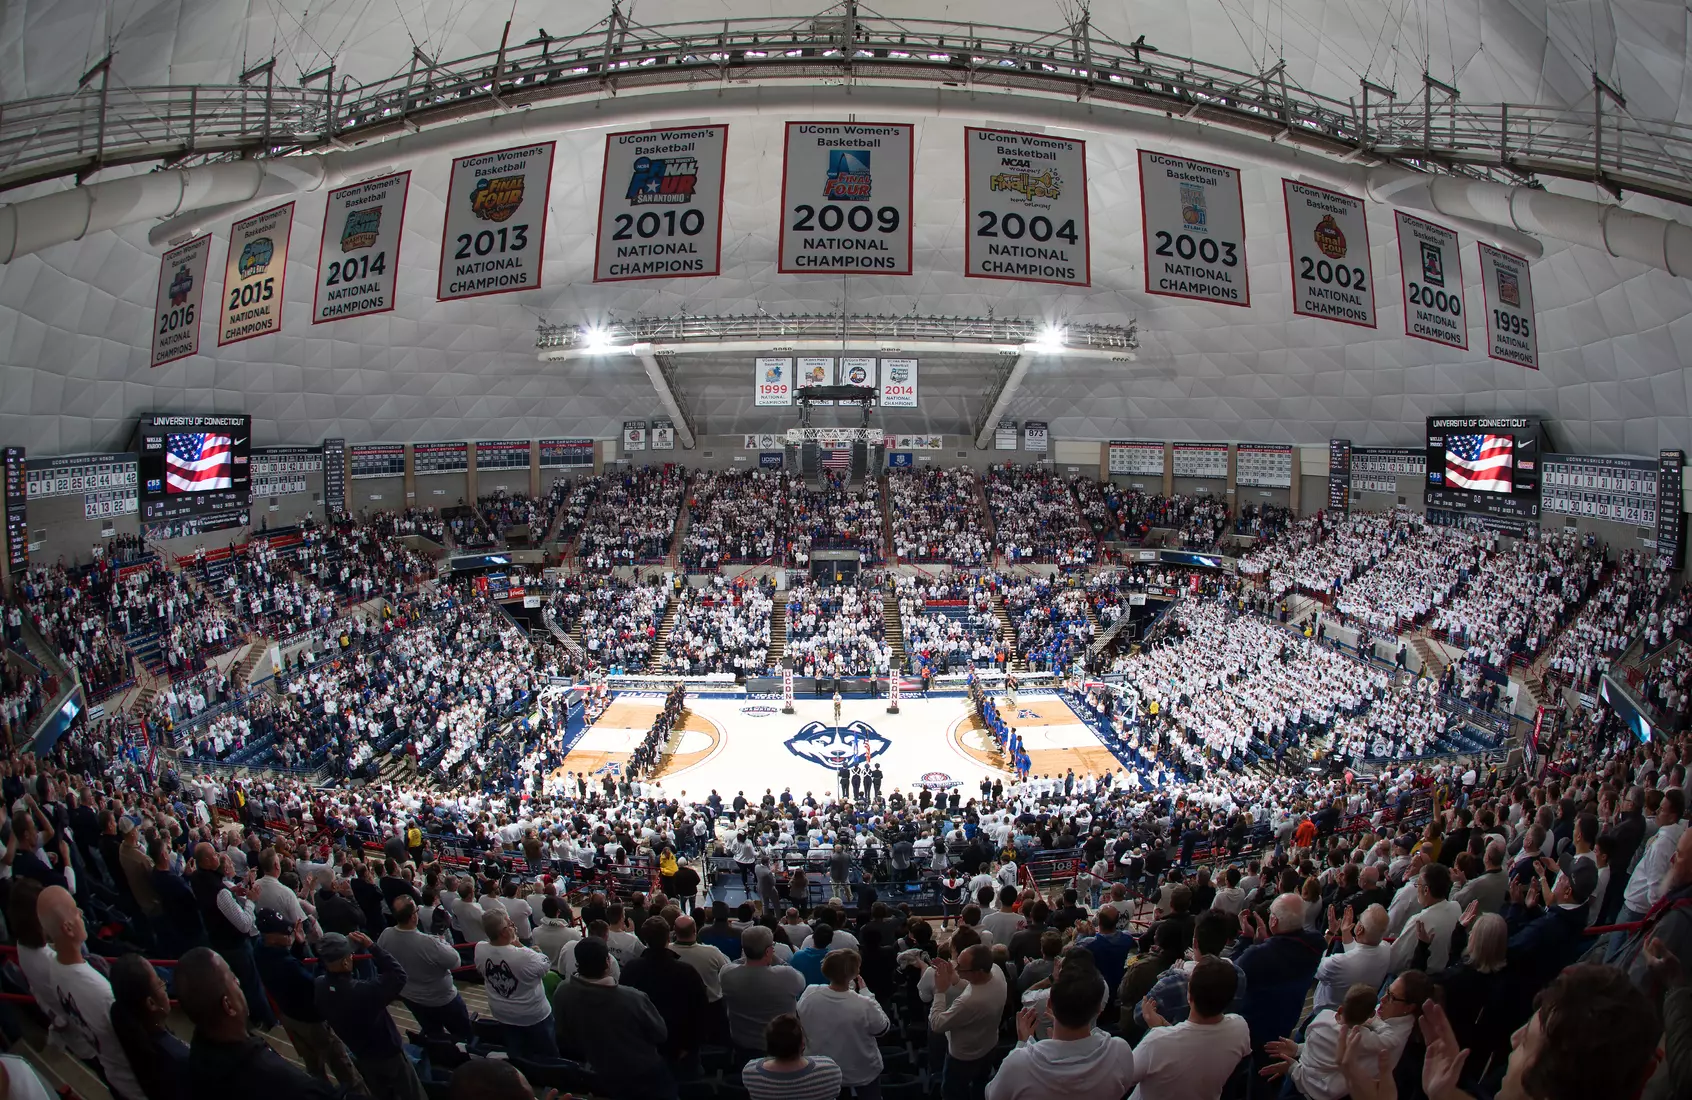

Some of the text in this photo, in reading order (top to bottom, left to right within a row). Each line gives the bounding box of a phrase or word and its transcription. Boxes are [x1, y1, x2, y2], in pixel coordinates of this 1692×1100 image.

[619, 129, 714, 145] UConn Women's
[800, 125, 900, 136] UConn Women's
[635, 143, 695, 155] Basketball
[817, 138, 881, 148] Basketball
[978, 132, 1074, 150] UConn Women's
[462, 148, 543, 168] UConn Women's
[996, 146, 1056, 160] Basketball
[474, 162, 526, 177] Basketball
[1001, 158, 1032, 168] NCAA
[1150, 156, 1230, 178] UConn Women's
[488, 178, 525, 193] FINAL
[838, 172, 872, 184] FINAL
[1166, 169, 1218, 186] Basketball
[336, 177, 400, 200] UConn Women's
[824, 178, 872, 196] FOUR
[346, 192, 386, 208] Basketball
[473, 190, 524, 211] FOUR
[637, 193, 685, 203] SAN ANTONIO
[1292, 184, 1358, 208] UConn Women's
[1306, 199, 1348, 216] Basketball
[612, 209, 705, 240] 2010
[792, 204, 900, 234] 2009
[977, 210, 1078, 246] 2004
[454, 224, 528, 260] 2013
[803, 238, 888, 251] NATIONAL
[1316, 232, 1341, 246] Final
[617, 242, 698, 258] NATIONAL
[988, 244, 1068, 262] NATIONAL
[1155, 230, 1238, 267] 2003
[326, 252, 386, 287] 2014
[456, 257, 523, 276] NATIONAL
[609, 259, 703, 276] CHAMPIONS
[795, 255, 896, 268] CHAMPIONS
[982, 260, 1076, 279] CHAMPIONS
[1164, 262, 1232, 283] NATIONAL
[1300, 256, 1367, 292] 2002
[450, 272, 527, 294] CHAMPIONS
[1160, 278, 1238, 300] CHAMPIONS
[228, 278, 274, 311] 2015
[328, 282, 380, 301] NATIONAL
[1308, 286, 1362, 306] NATIONAL
[1408, 282, 1461, 316] 2000
[230, 304, 270, 324] NATIONAL
[322, 297, 384, 317] CHAMPIONS
[1305, 300, 1368, 322] CHAMPIONS
[160, 304, 195, 335] 2016
[1416, 310, 1457, 330] NATIONAL
[1494, 309, 1530, 338] 1995
[226, 318, 272, 339] CHAMPIONS
[1414, 324, 1461, 344] CHAMPIONS
[160, 330, 190, 348] NATIONAL
[1497, 334, 1530, 350] NATIONAL
[156, 342, 192, 361] CHAMPIONS
[1495, 346, 1533, 364] CHAMPIONS
[760, 384, 788, 394] 1999
[885, 386, 913, 395] 2014
[153, 417, 245, 426] UNIVERSITY OF CONNECTICUT
[1433, 419, 1527, 428] UNIVERSITY OF CONNECTICUT
[289, 463, 296, 471] 42
[57, 480, 68, 490] 22
[72, 478, 82, 488] 25
[86, 476, 97, 486] 42
[100, 475, 110, 486] 44
[126, 473, 136, 482] 42
[1602, 477, 1608, 488] 31
[1615, 479, 1622, 489] 23
[1630, 480, 1638, 490] 31
[30, 483, 37, 493] C
[46, 482, 51, 491] 9
[1646, 482, 1653, 492] 14
[86, 504, 97, 515] 24
[101, 503, 110, 512] 13
[114, 501, 124, 510] 22
[1543, 497, 1552, 507] 23
[1559, 499, 1564, 508] 4
[1571, 501, 1580, 511] 30
[1587, 503, 1591, 512] 3
[1614, 506, 1622, 516] 15
[1628, 509, 1638, 519] 24
[1643, 511, 1654, 521] 33
[1052, 862, 1073, 871] 108
